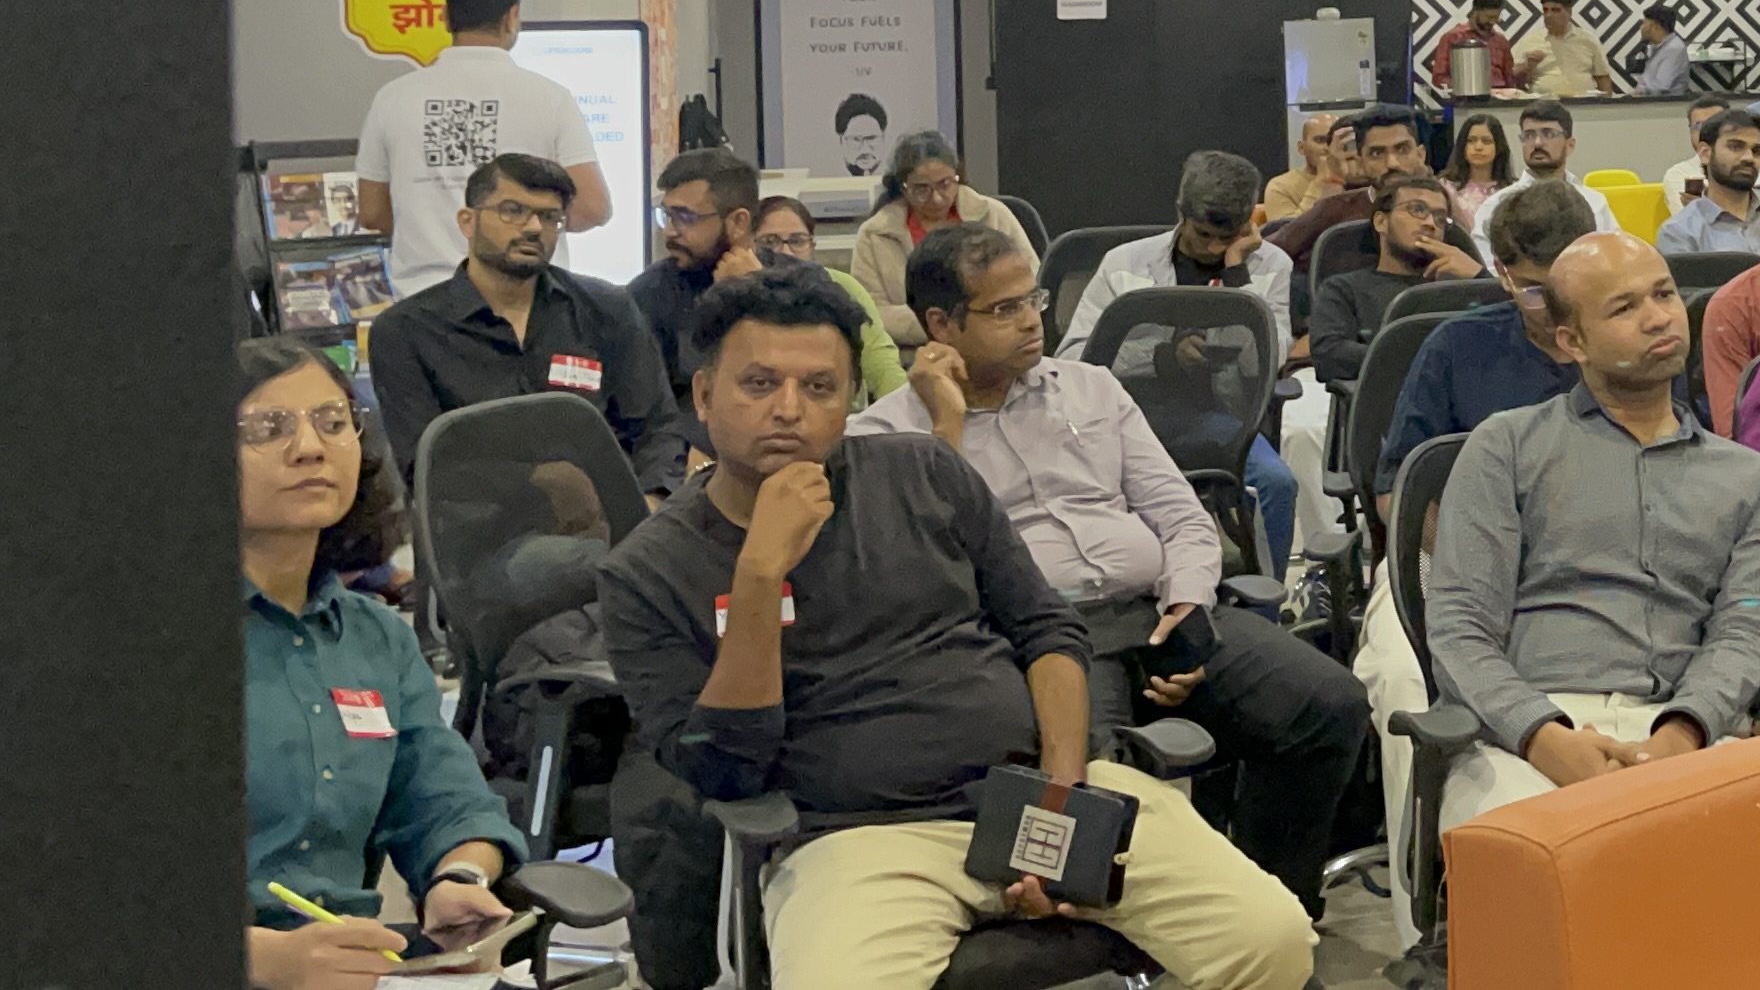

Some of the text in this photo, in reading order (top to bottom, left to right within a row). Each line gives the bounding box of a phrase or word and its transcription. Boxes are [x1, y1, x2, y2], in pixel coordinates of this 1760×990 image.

[810, 15, 902, 28] FOCUS FUELS
[809, 40, 908, 53] YOUR FUTURE.
[575, 95, 616, 104] NUAL
